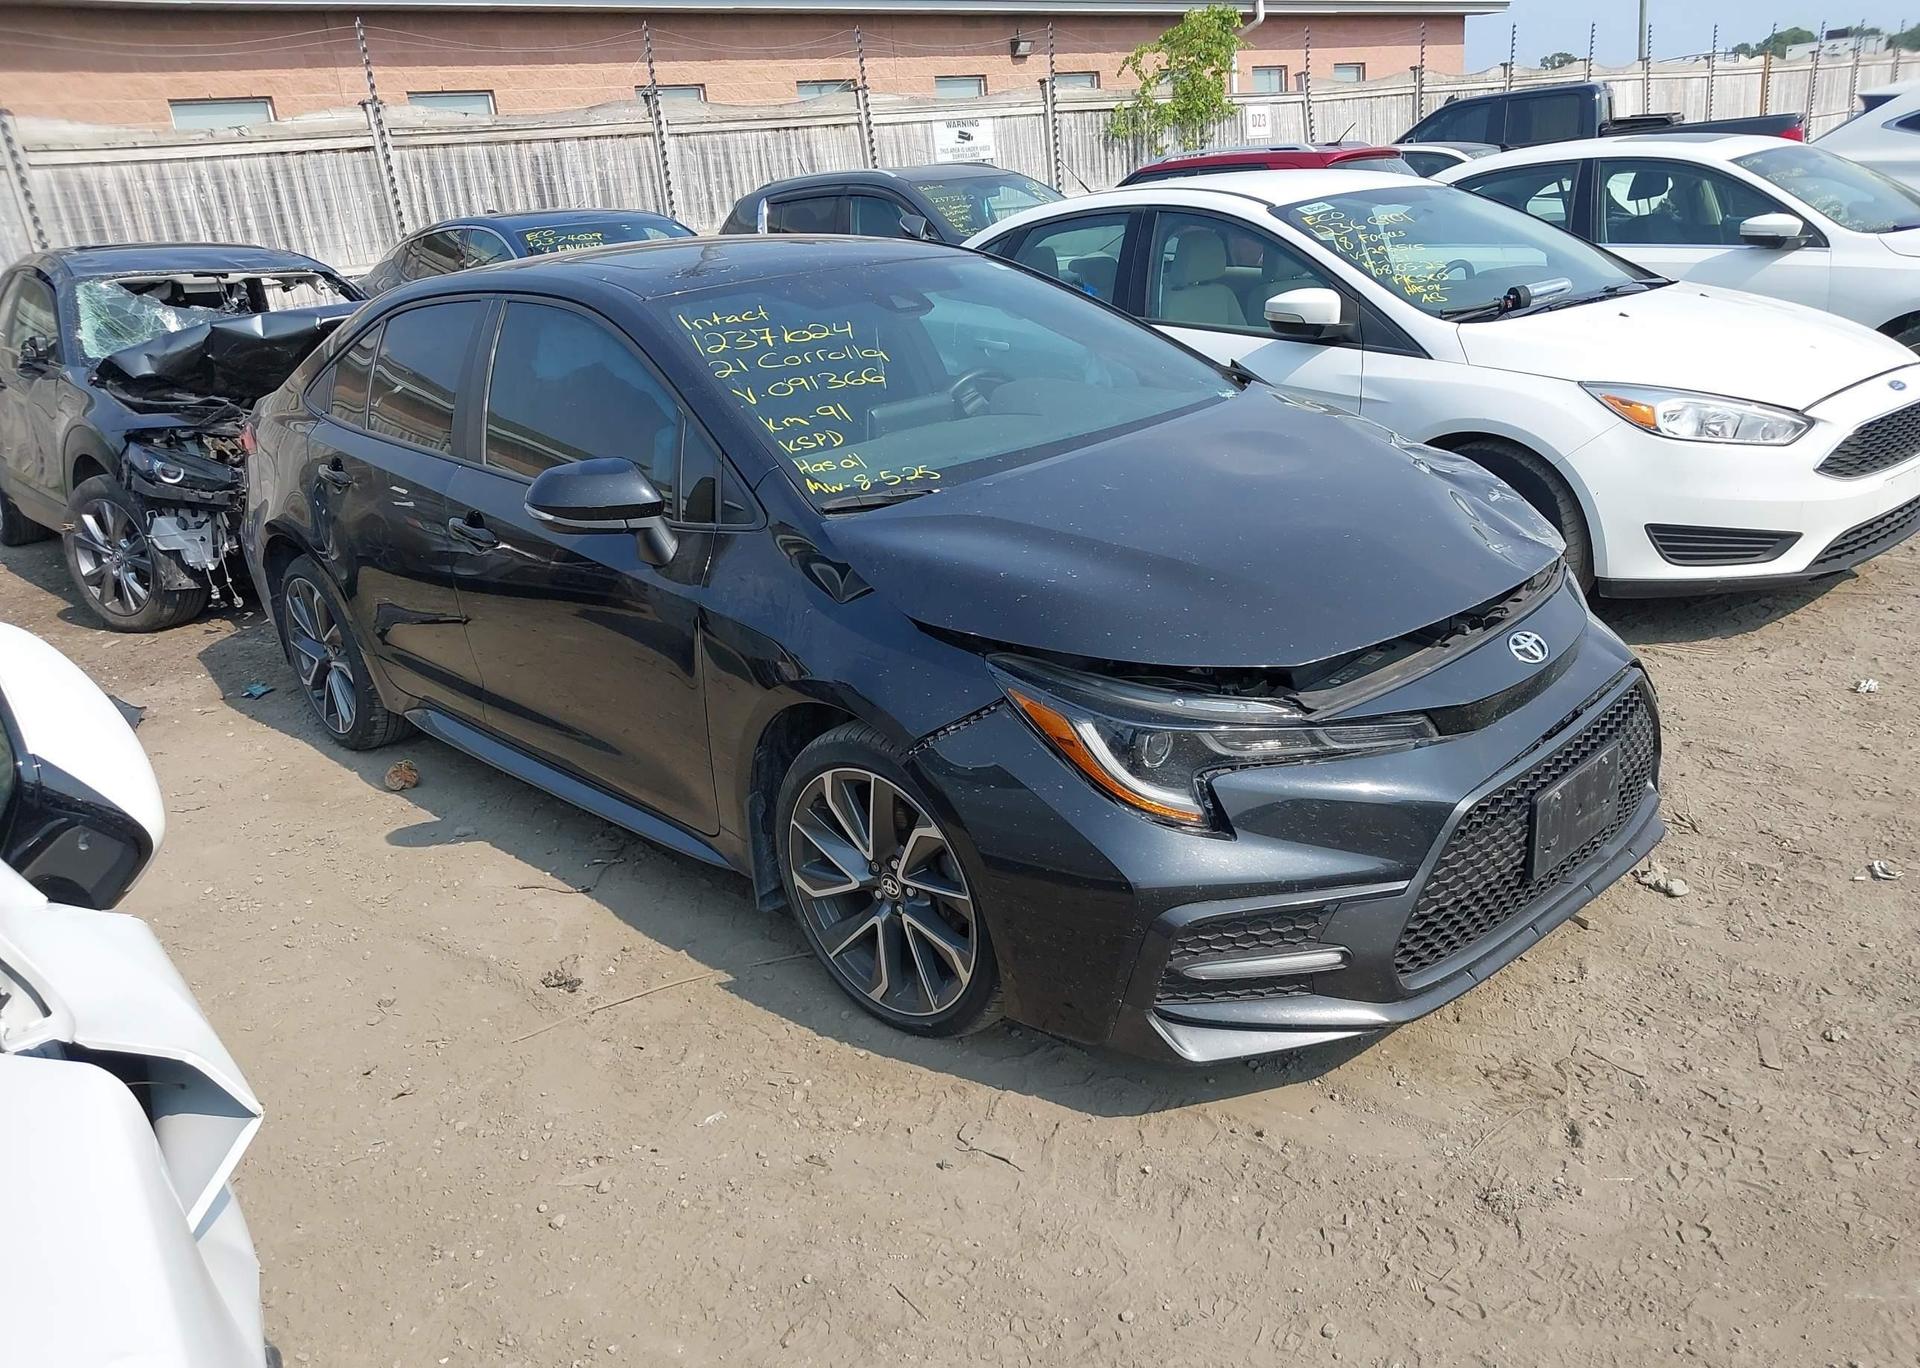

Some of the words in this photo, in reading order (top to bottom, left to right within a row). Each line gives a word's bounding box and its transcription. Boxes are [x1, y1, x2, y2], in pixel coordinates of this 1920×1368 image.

[945, 119, 980, 129] WARNING
[1301, 211, 1345, 226] ECO
[525, 230, 556, 241] ECO
[677, 305, 770, 331] Intact
[691, 320, 854, 357] 12371024
[708, 357, 749, 379] 21
[778, 430, 844, 454] KSPD
[792, 459, 837, 475] Has
